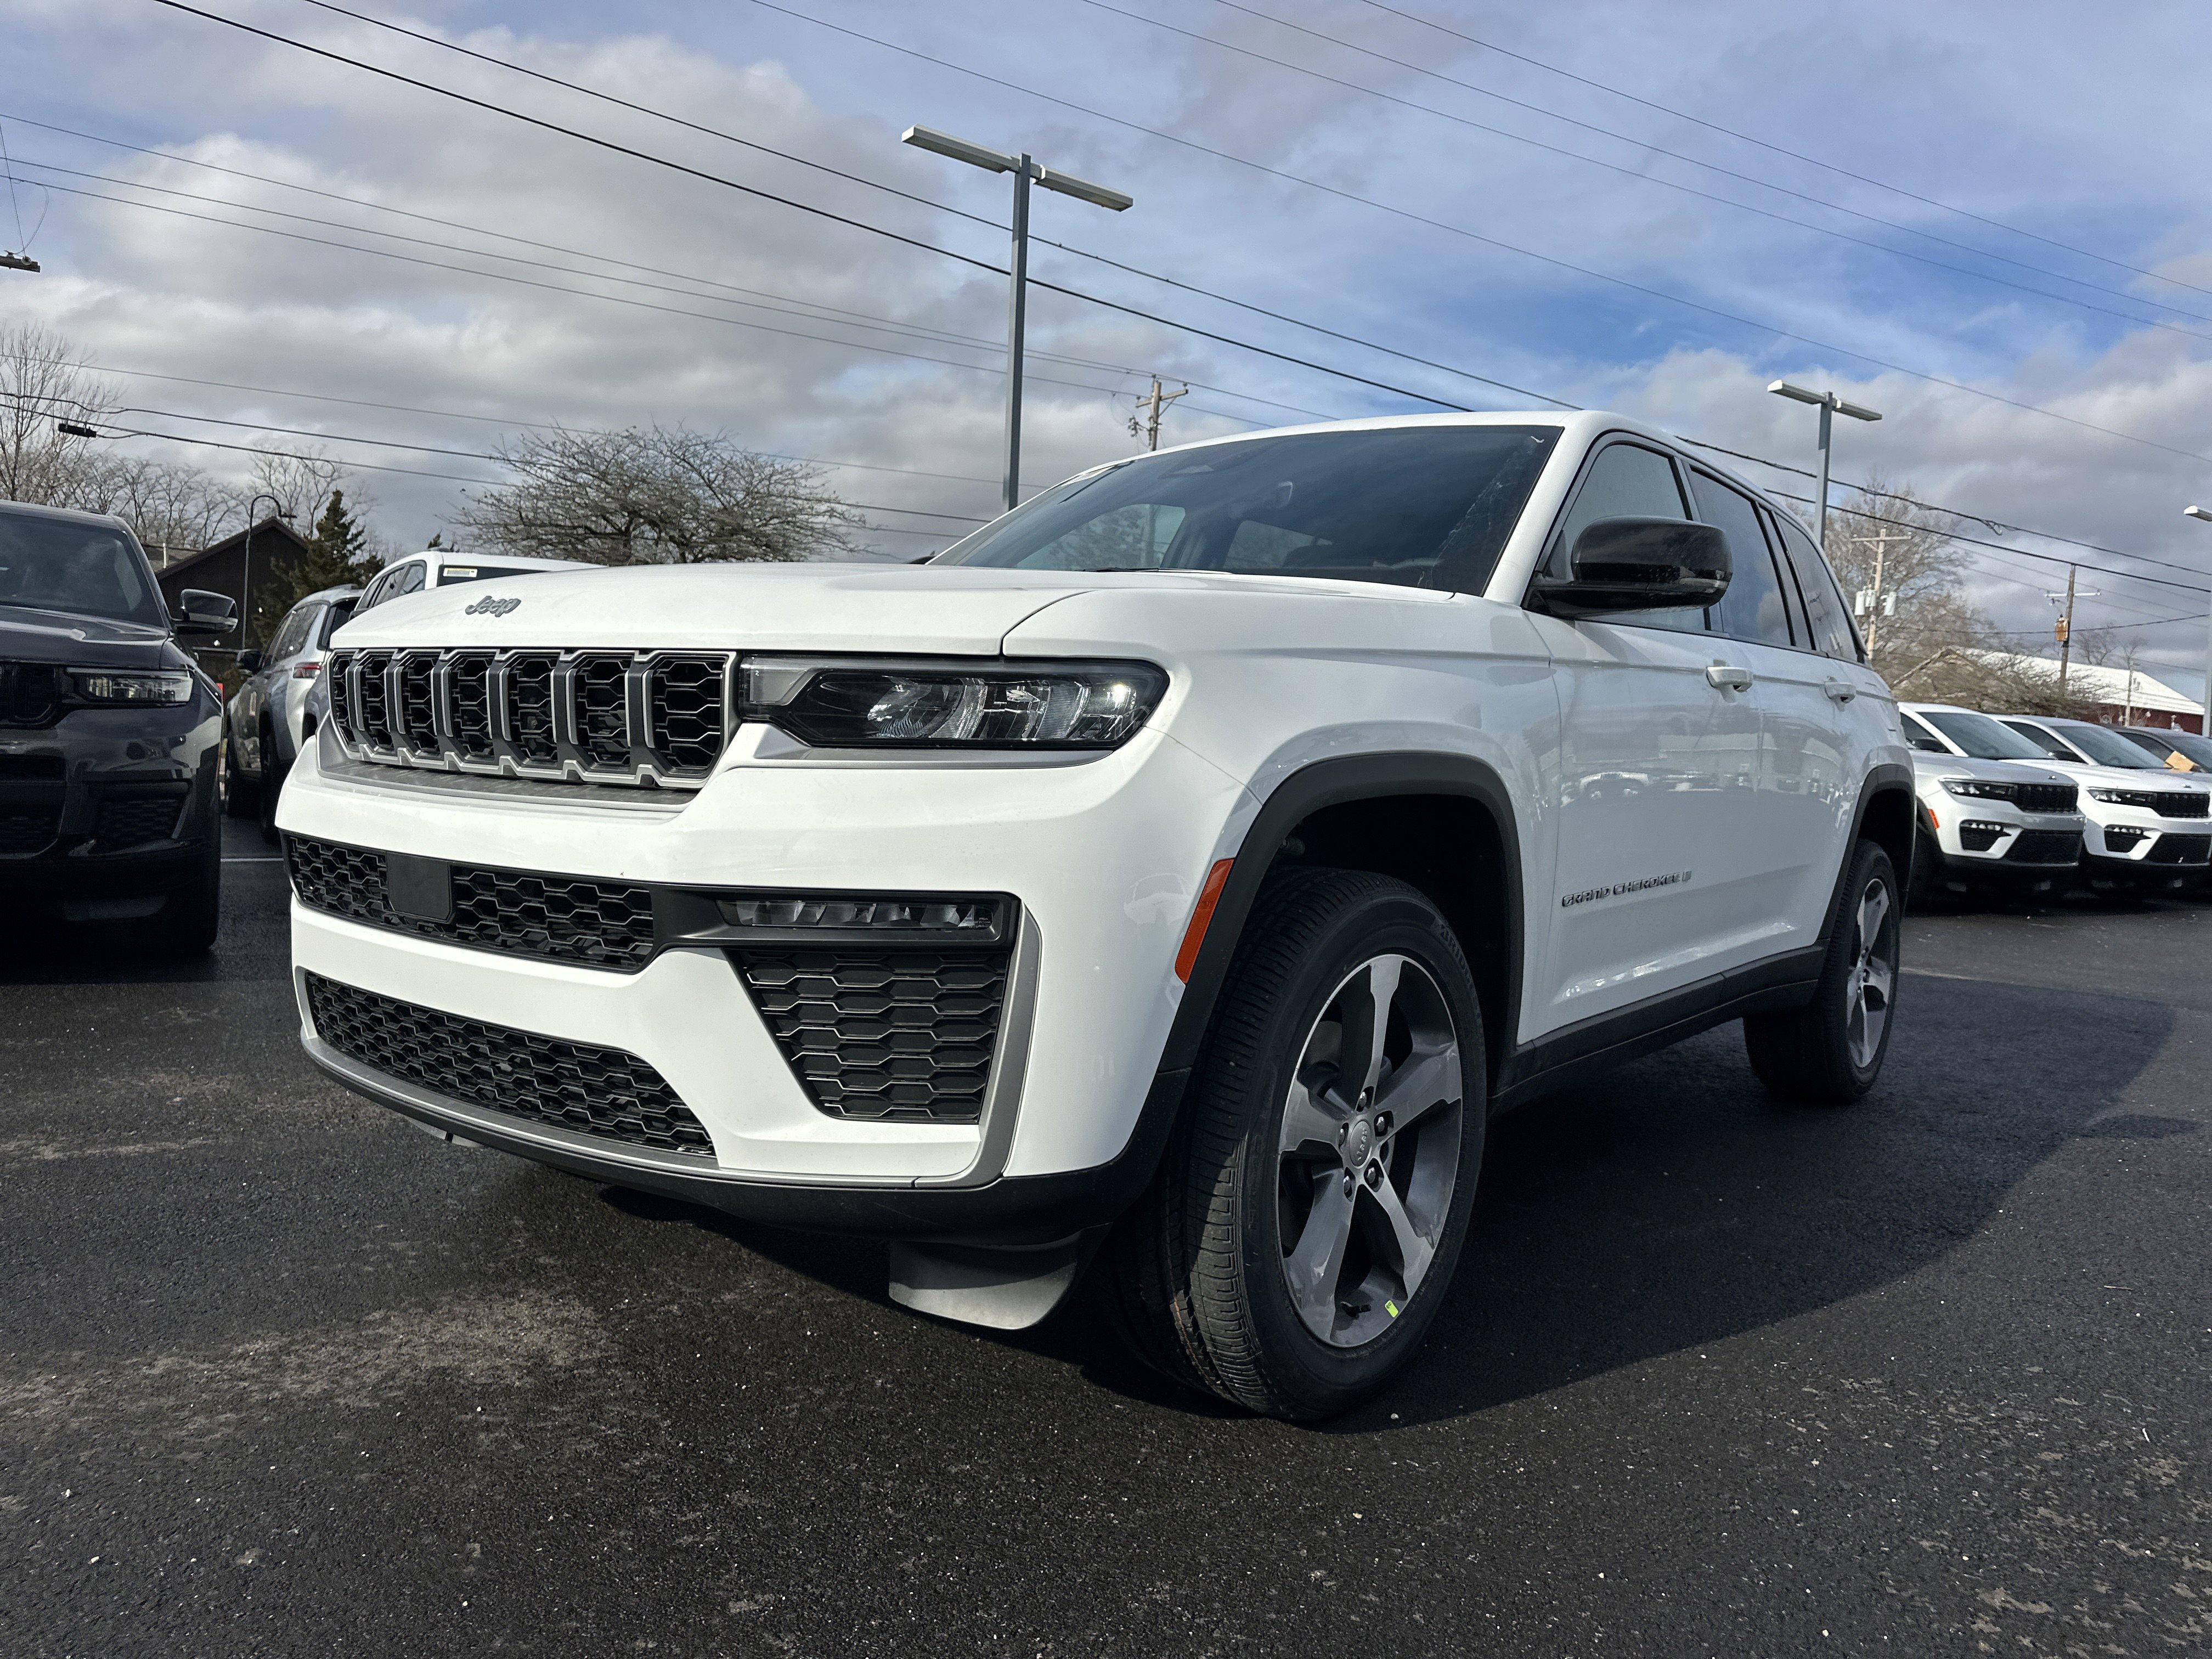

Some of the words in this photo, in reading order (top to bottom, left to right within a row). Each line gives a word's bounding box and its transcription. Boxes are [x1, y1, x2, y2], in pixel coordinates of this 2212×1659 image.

[465, 595, 522, 618] Jeep
[1561, 886, 1611, 907] GRAND
[1612, 872, 1681, 895] CHEROKEE
